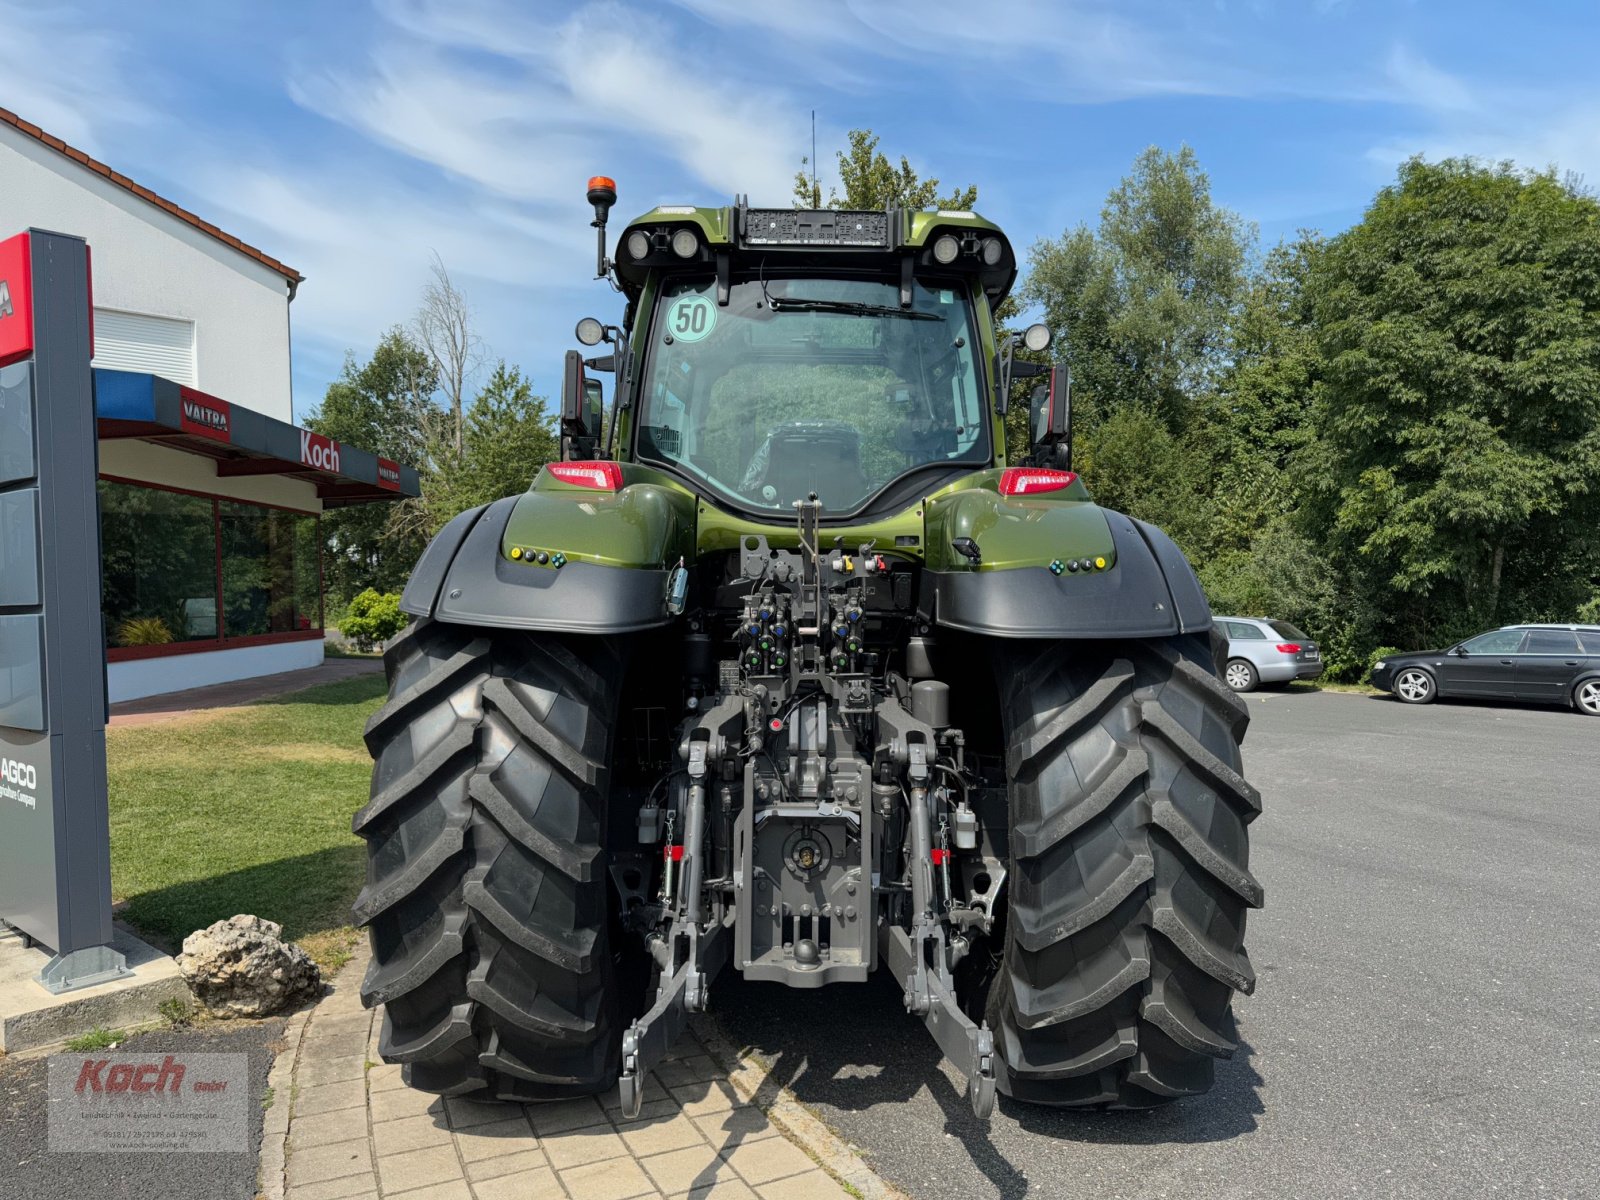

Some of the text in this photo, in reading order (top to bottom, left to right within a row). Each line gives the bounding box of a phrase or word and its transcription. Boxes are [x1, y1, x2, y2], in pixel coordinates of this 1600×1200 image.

[675, 303, 707, 334] 50
[183, 399, 228, 432] VALTRA
[300, 429, 340, 473] Koch
[1, 757, 37, 790] AGCO
